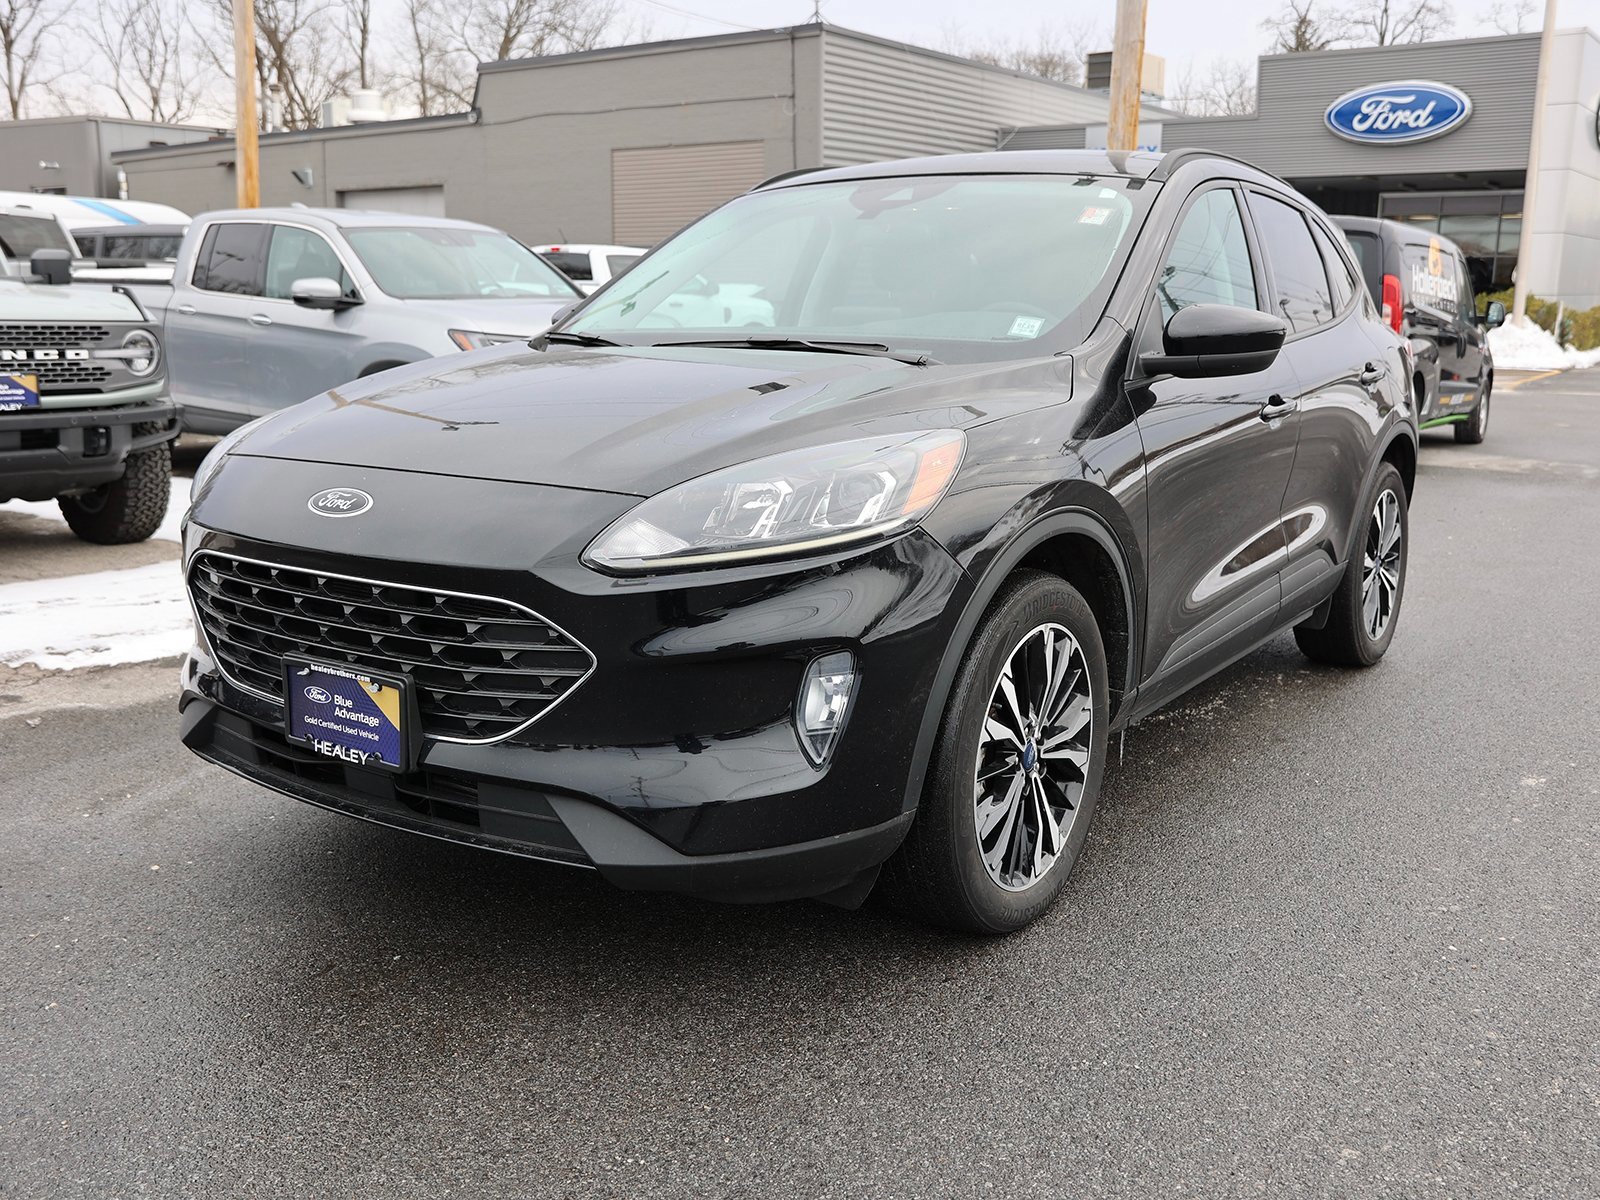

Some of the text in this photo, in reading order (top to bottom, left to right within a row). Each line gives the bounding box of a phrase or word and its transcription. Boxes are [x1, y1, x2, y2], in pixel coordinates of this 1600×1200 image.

[1352, 94, 1437, 132] Ford
[318, 491, 358, 510] Ford
[310, 663, 371, 683] healeybrothers.com
[309, 687, 327, 701] Ford
[333, 694, 353, 708] Blue
[334, 706, 380, 727] Advantage
[304, 715, 380, 741] Gold Certified Used Vehicle
[314, 738, 370, 766] HEALEY
